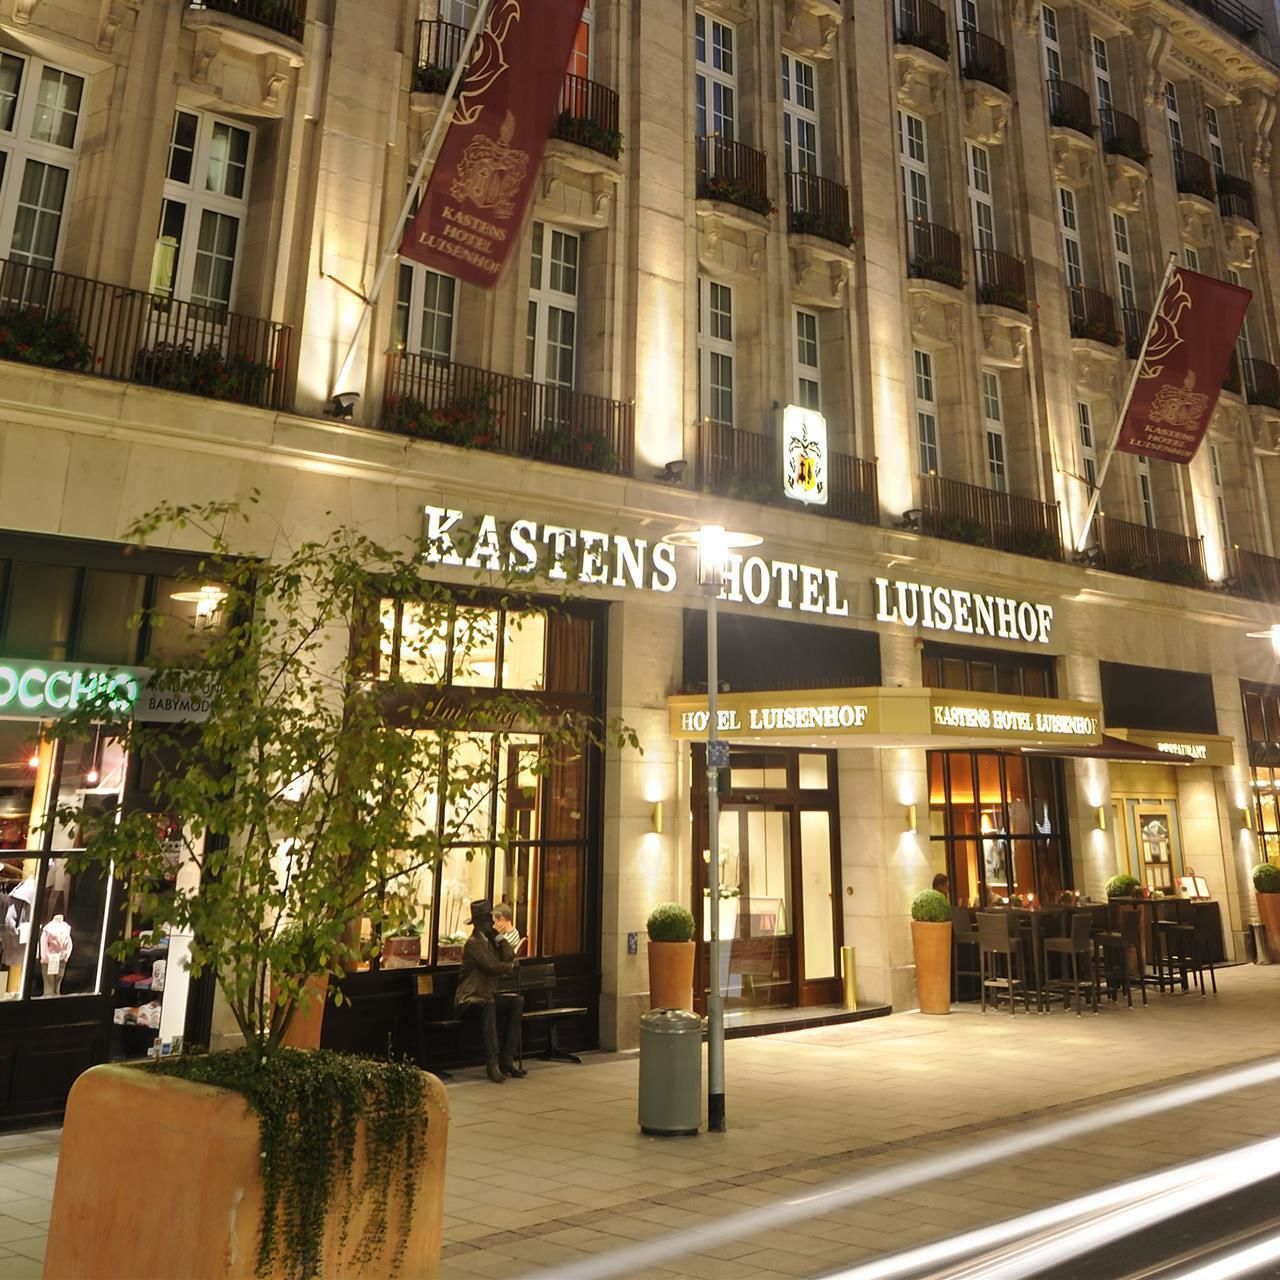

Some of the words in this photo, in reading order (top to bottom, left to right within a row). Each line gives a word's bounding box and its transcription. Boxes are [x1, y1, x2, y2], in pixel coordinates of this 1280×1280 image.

[442, 206, 507, 241] KASTENS
[419, 231, 502, 274] LUISENHOF
[443, 224, 493, 253] HOTEL
[1144, 424, 1195, 442] KASTENS
[1147, 434, 1186, 448] HOTEL
[421, 505, 679, 592] KASTENS
[716, 554, 849, 617] HOTEL
[875, 577, 1055, 644] LUISENHOF
[148, 698, 211, 713] BABYMOD
[681, 710, 741, 731] HOEL
[750, 705, 868, 729] LUISENHOF
[933, 706, 991, 729] KASTENS
[992, 710, 1034, 731] HOTEL
[1035, 713, 1098, 735] LUISENHOF
